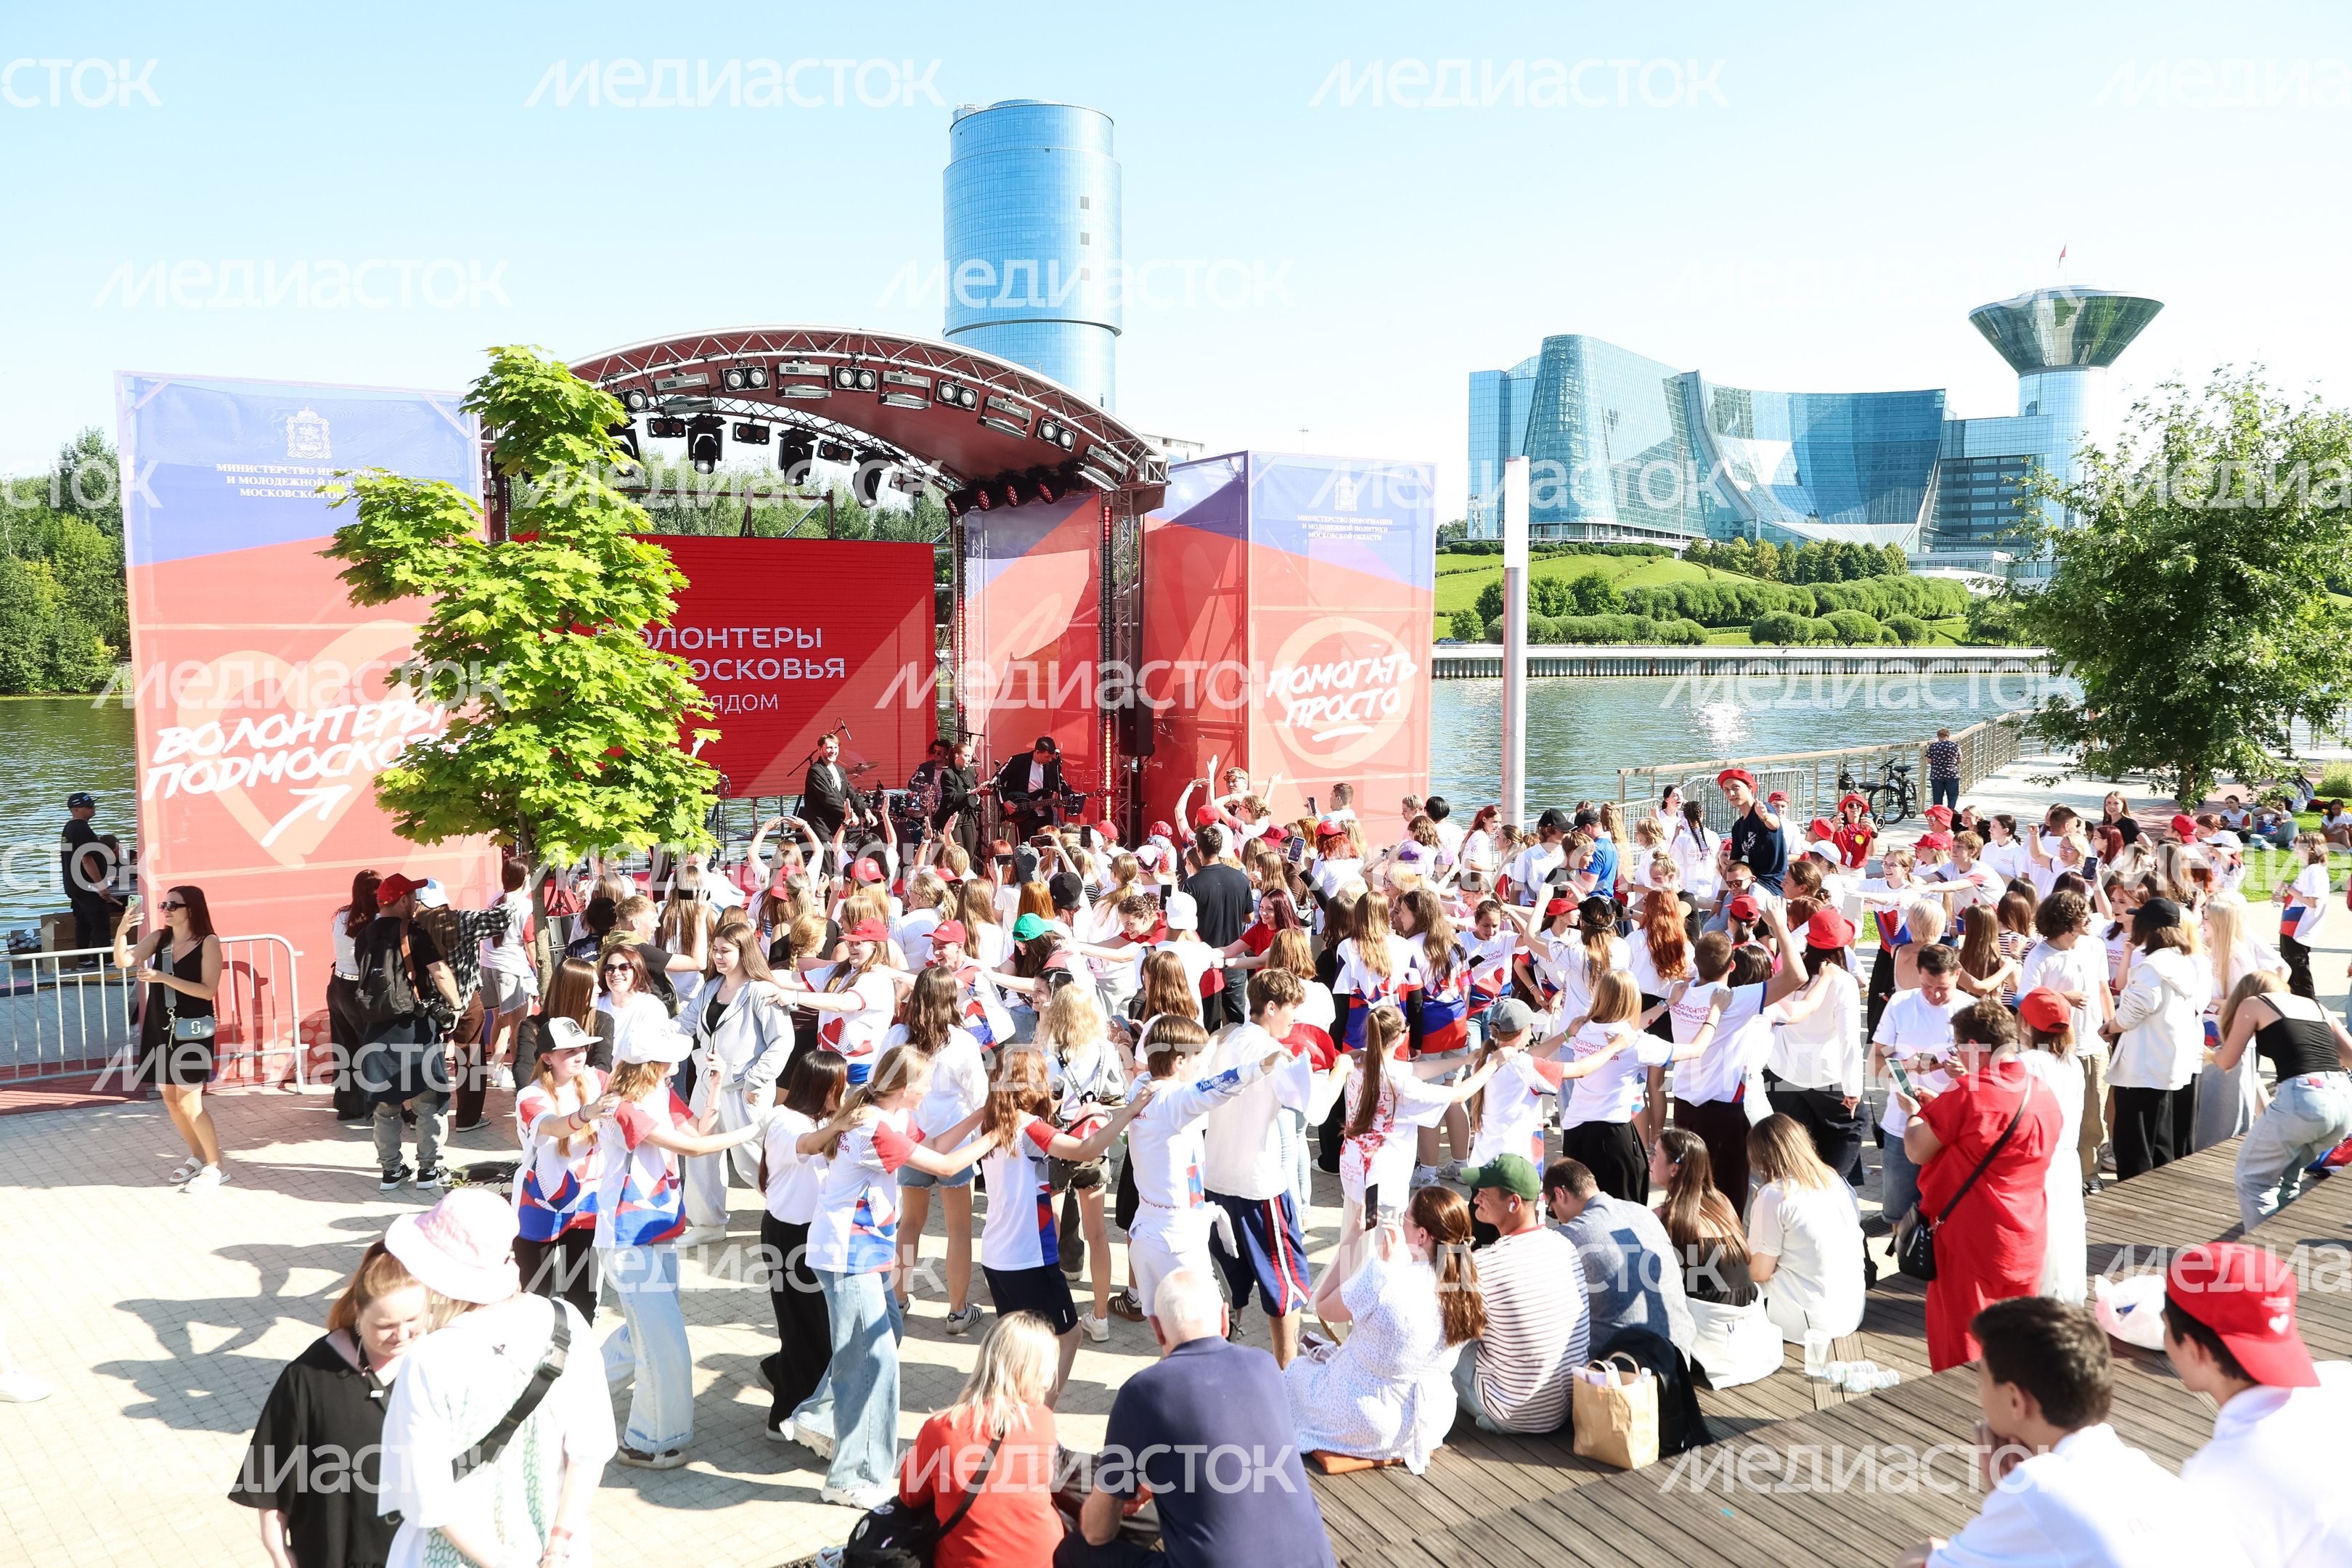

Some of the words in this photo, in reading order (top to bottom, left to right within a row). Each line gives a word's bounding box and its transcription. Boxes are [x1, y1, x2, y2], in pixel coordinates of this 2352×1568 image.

[216, 463, 314, 475] МИНИСТЕРСТВО
[238, 477, 325, 487] МОЛОДЕЖНОЙ
[1266, 653, 1418, 698] ПОМОГАТЬ
[1284, 687, 1401, 729] ПРОСТО
[152, 697, 446, 764] ВОЛОНТЕРЫ
